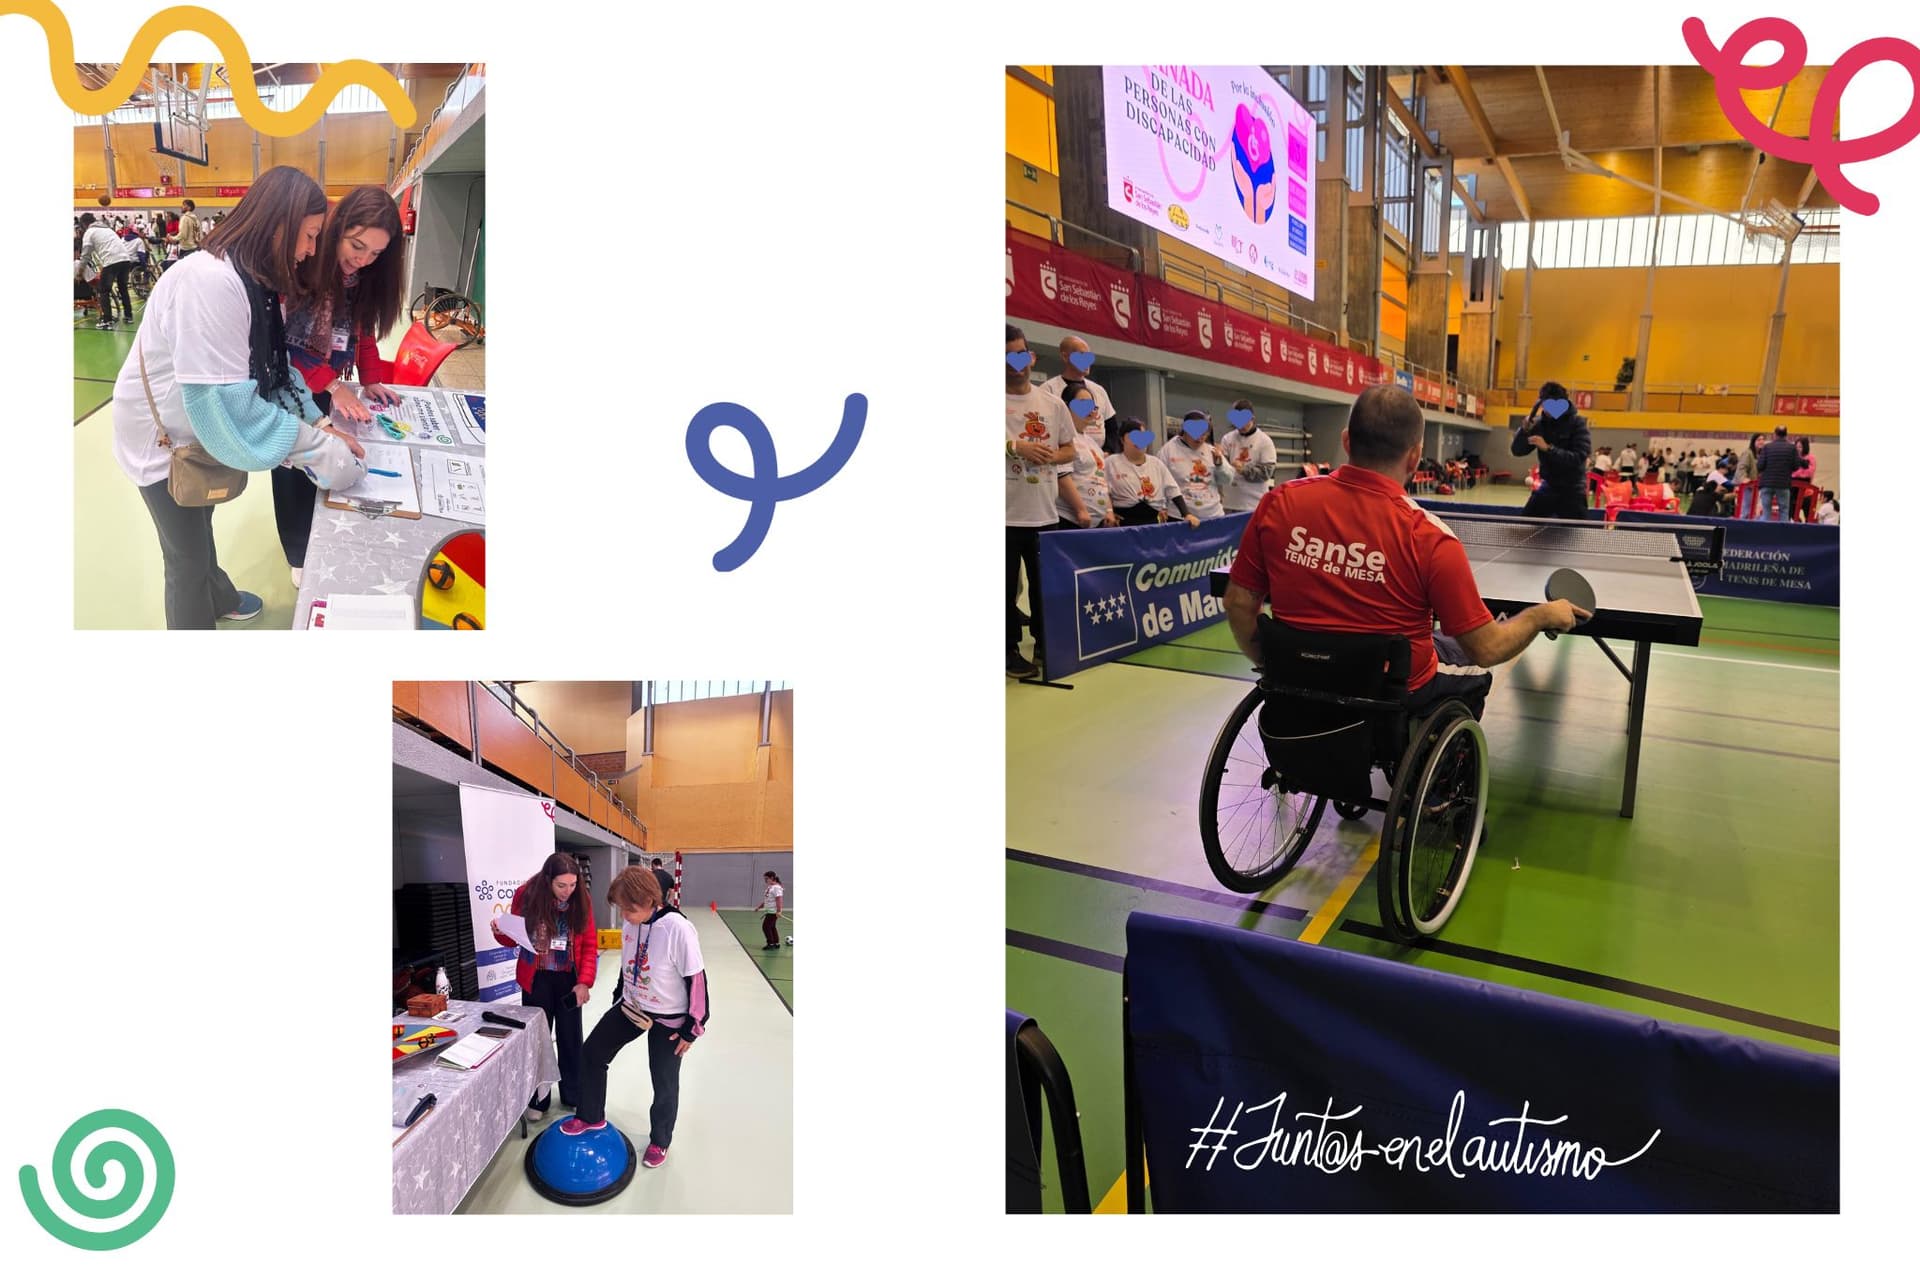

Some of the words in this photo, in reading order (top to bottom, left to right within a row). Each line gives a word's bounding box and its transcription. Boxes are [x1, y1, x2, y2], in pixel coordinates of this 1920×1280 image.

[1151, 72, 1167, 98] DE
[1171, 86, 1192, 115] LAS
[1125, 75, 1191, 135] PERSONAS
[1194, 126, 1215, 153] CON
[1126, 100, 1215, 172] DISCAPACIDAD
[1059, 280, 1072, 292] San
[1079, 297, 1097, 311] Reyes
[1285, 549, 1319, 569] TENIS
[1322, 562, 1341, 575] de
[1344, 567, 1386, 584] MESA
[1288, 526, 1386, 572] SanSe
[1723, 548, 1791, 562] EDERACIÓN
[1728, 574, 1759, 585] TENIS
[1761, 577, 1777, 587] DE
[1779, 579, 1812, 590] MESA
[1788, 565, 1806, 576] DE
[1142, 603, 1174, 638] de
